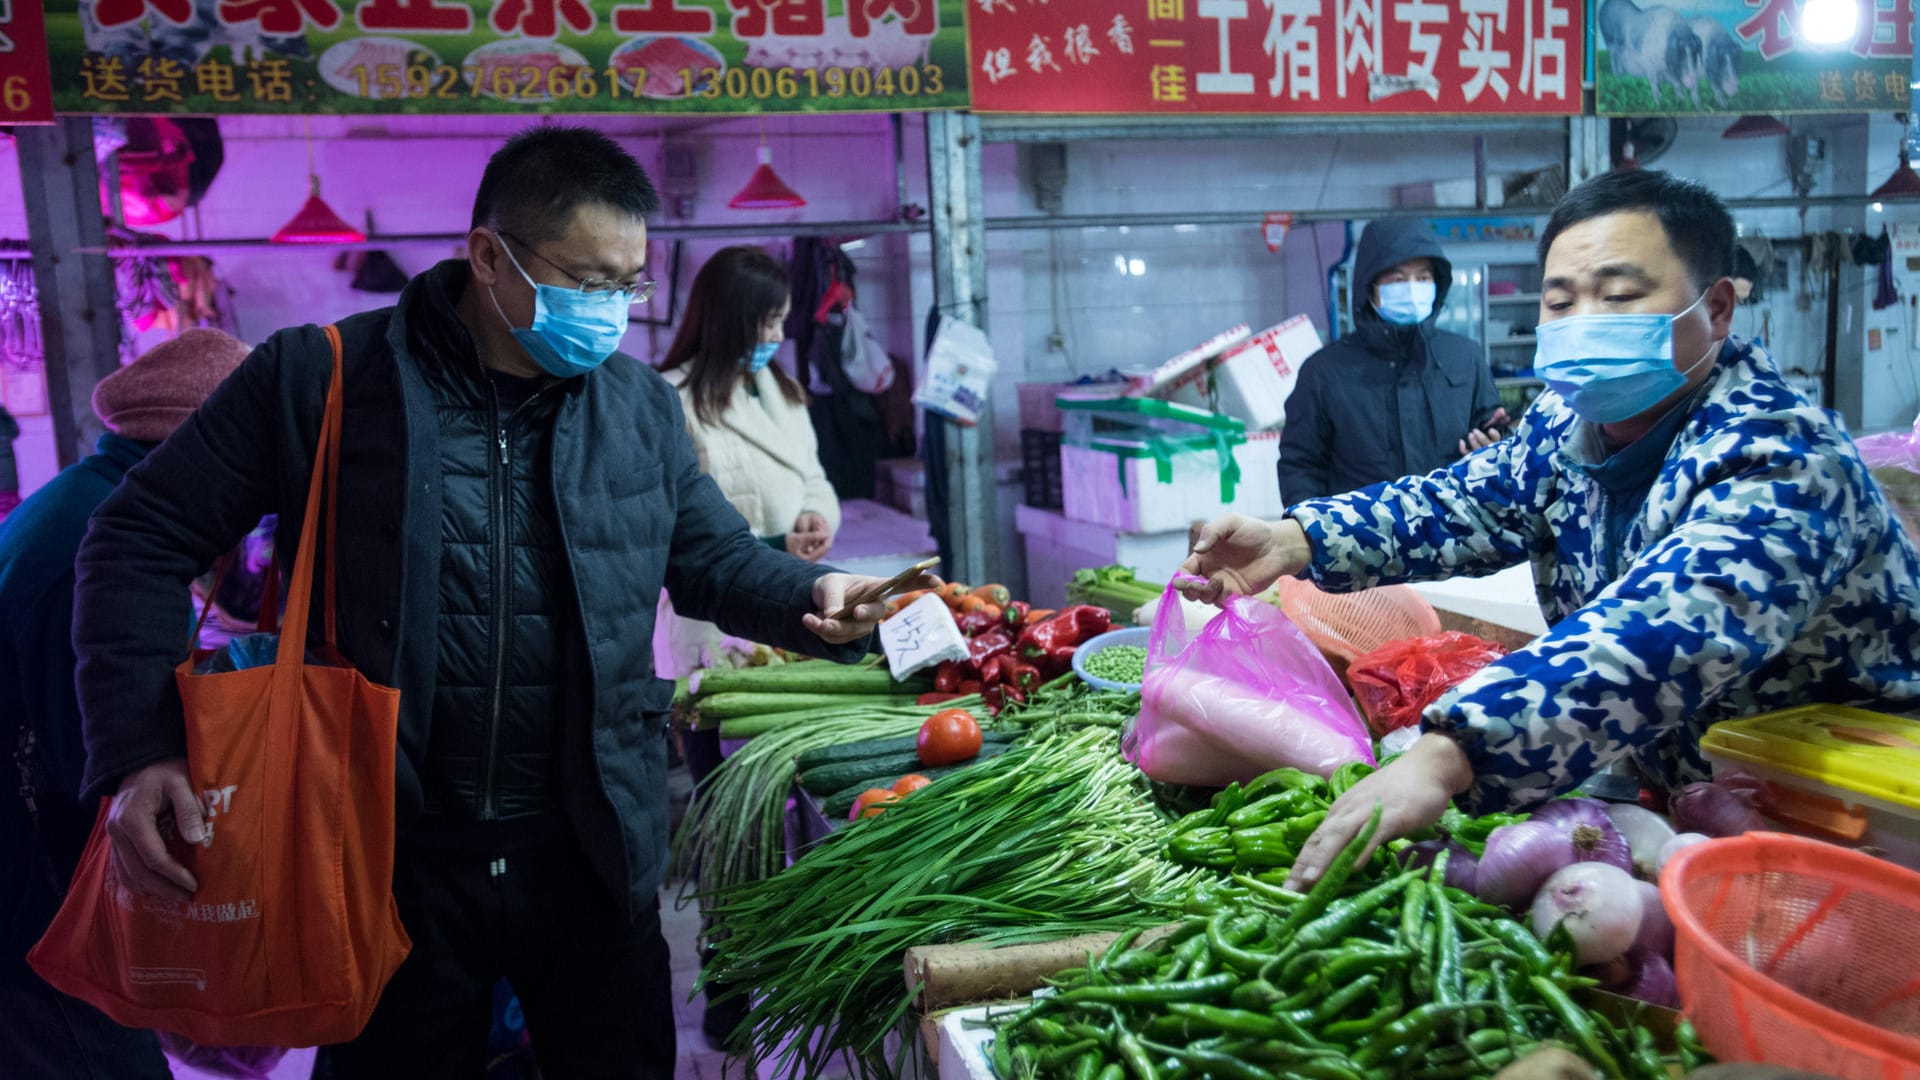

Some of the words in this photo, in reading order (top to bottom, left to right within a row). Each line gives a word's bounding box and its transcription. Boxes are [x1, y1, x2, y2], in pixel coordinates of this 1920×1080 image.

[982, 13, 1135, 84] 但我很香
[350, 63, 646, 99] 15927626617
[677, 64, 944, 99] 13006190403
